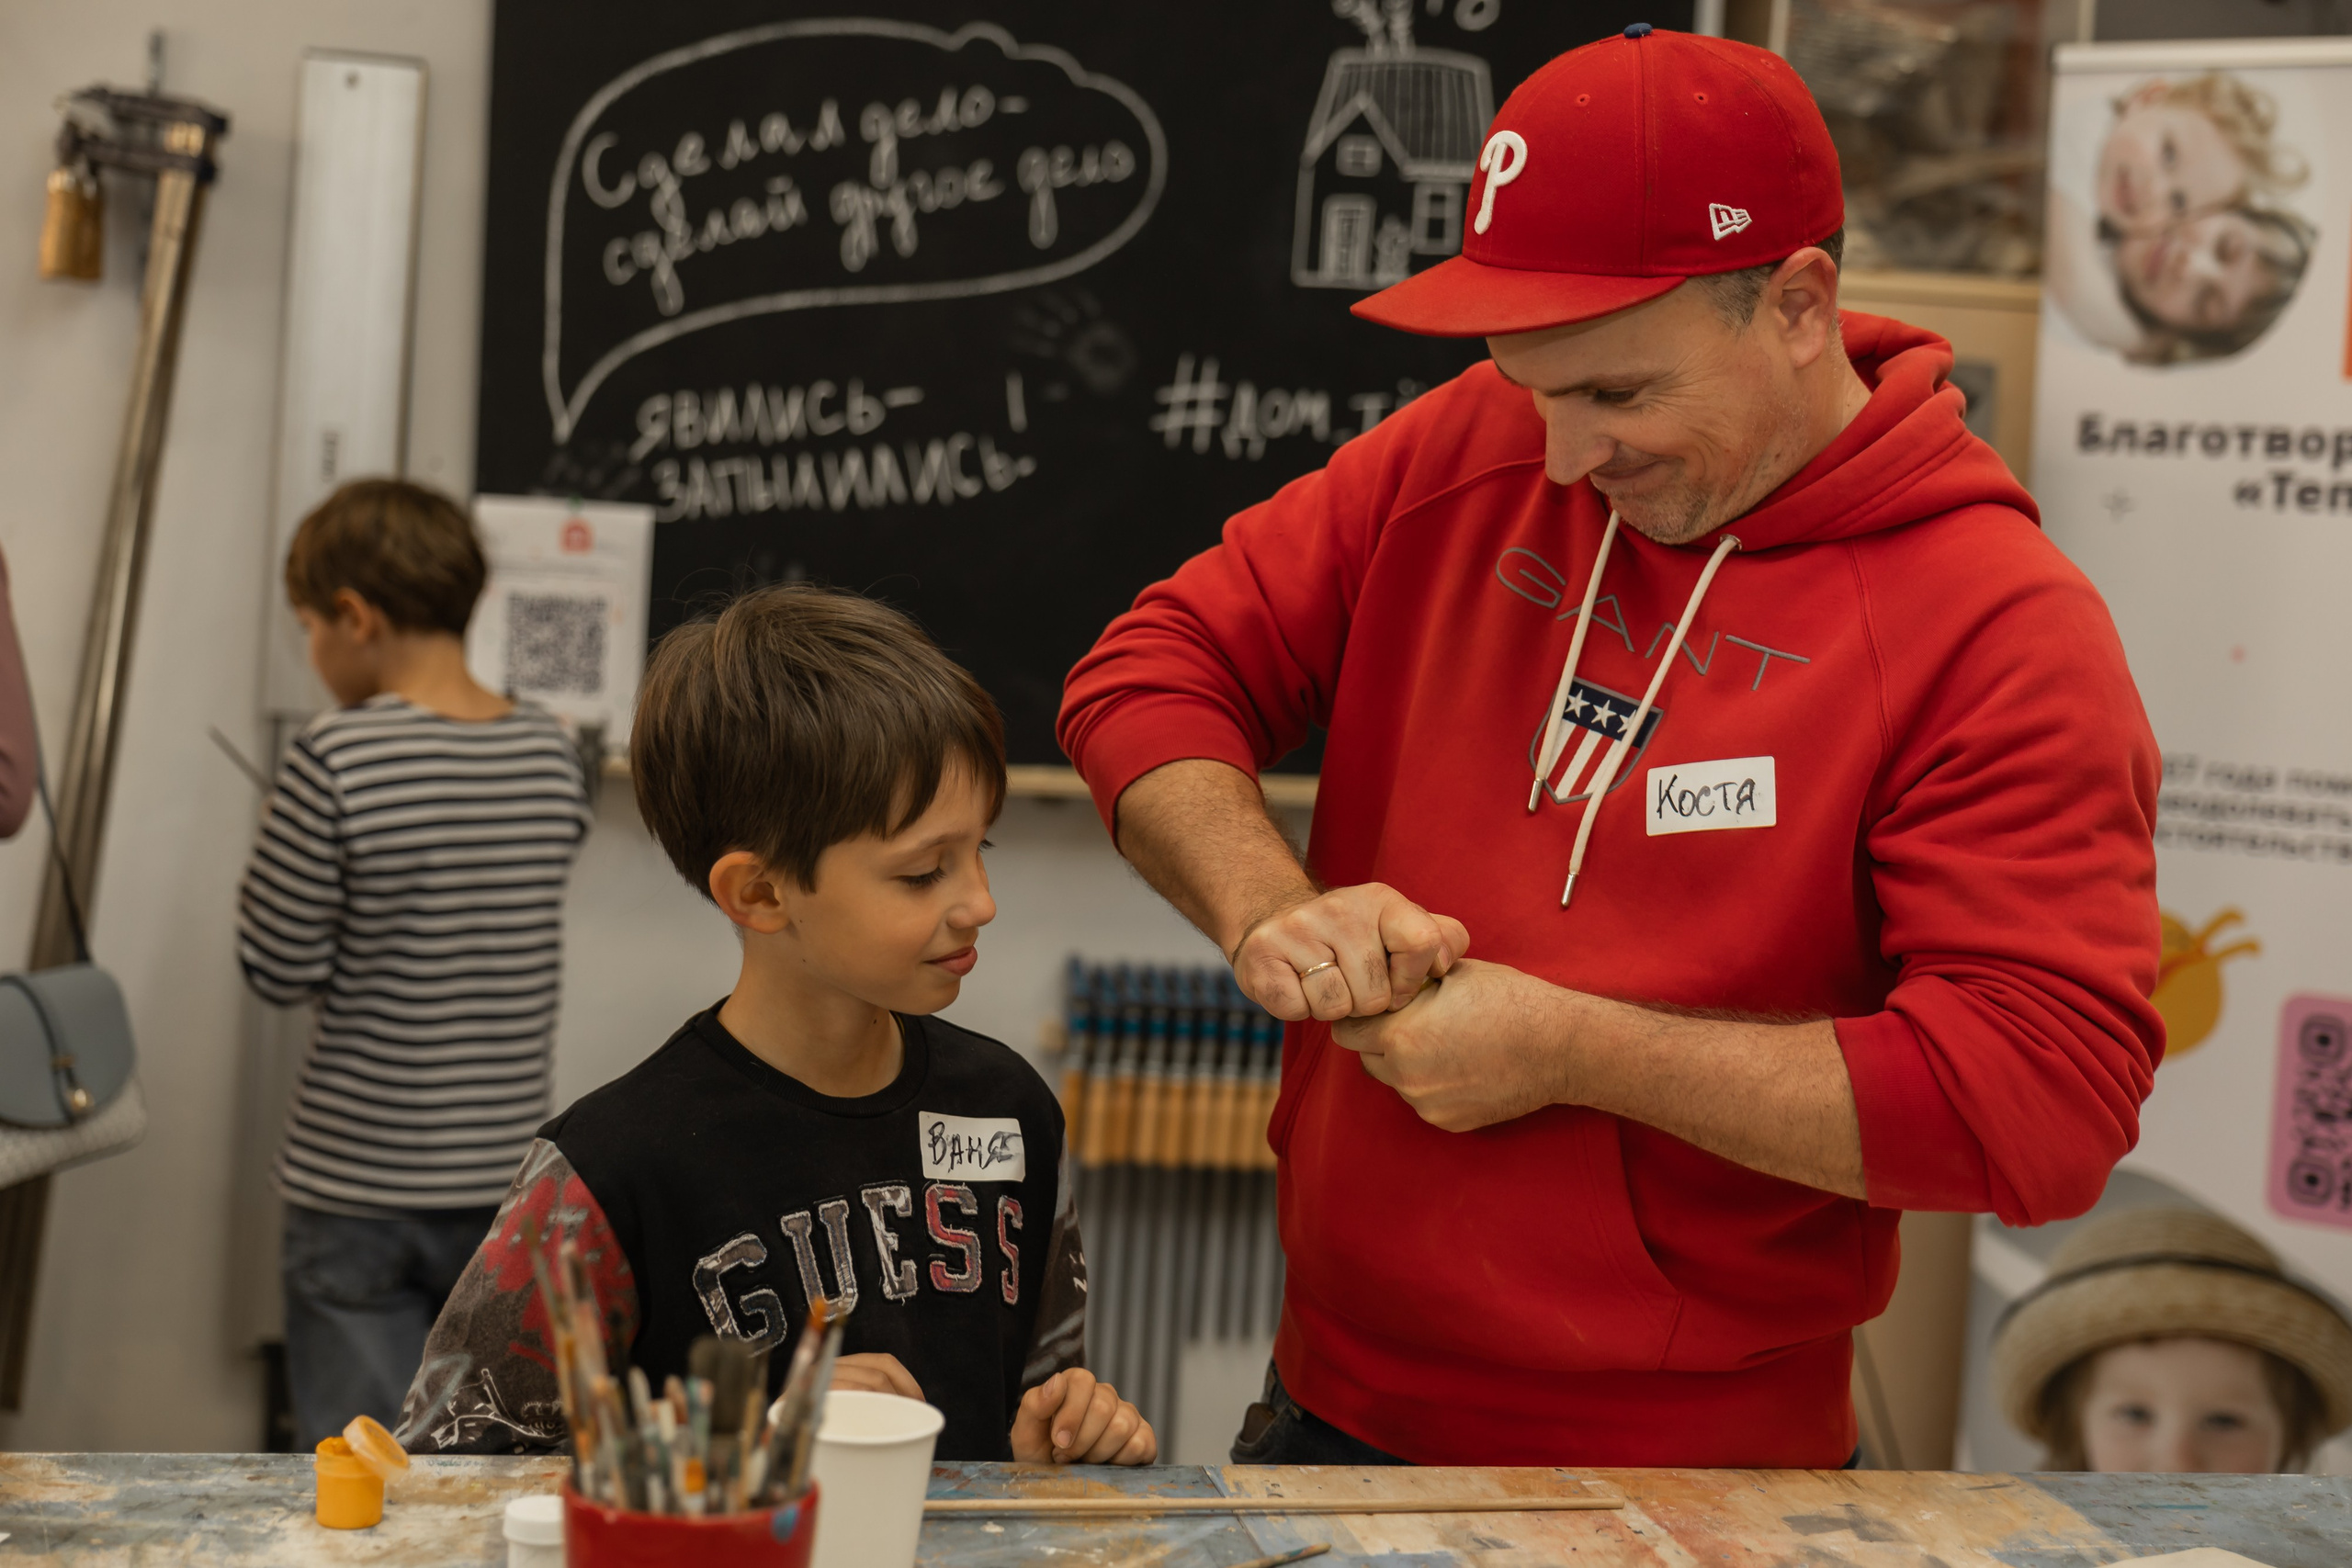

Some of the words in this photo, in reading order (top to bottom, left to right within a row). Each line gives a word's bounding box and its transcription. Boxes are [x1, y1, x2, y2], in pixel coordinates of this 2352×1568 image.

[1473, 130, 1529, 235] P
[1496, 547, 1811, 691] GANT
[692, 1180, 1025, 1357] GUESS
